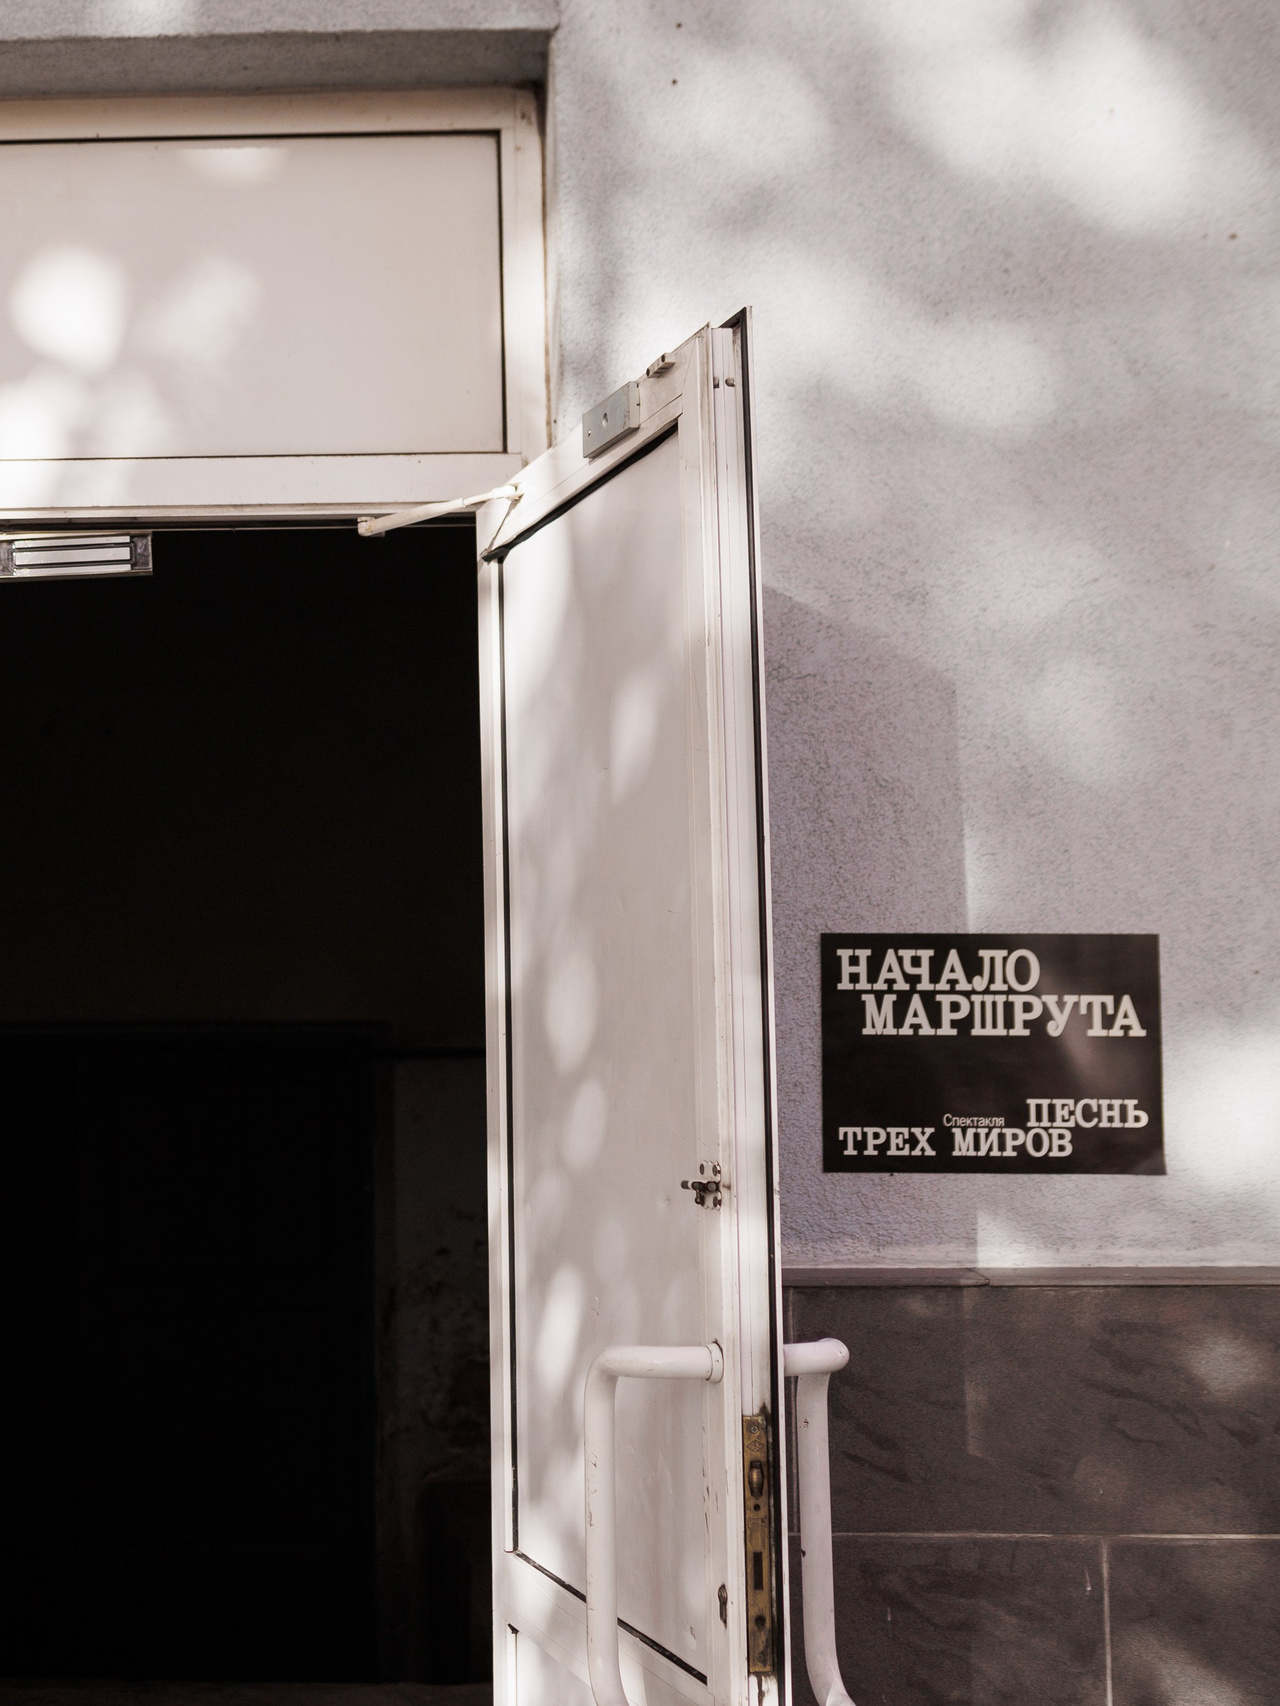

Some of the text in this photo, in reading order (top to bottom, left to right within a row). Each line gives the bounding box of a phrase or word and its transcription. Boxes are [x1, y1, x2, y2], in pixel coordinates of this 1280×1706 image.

[836, 948, 1041, 992] НАЧАЛО
[861, 994, 1147, 1037] МАРШРУТА
[943, 1113, 1005, 1127] Спектакля
[1026, 1098, 1149, 1128] ПЕСНЬ
[838, 1126, 1073, 1157] ТРЕХ МИРОВ
